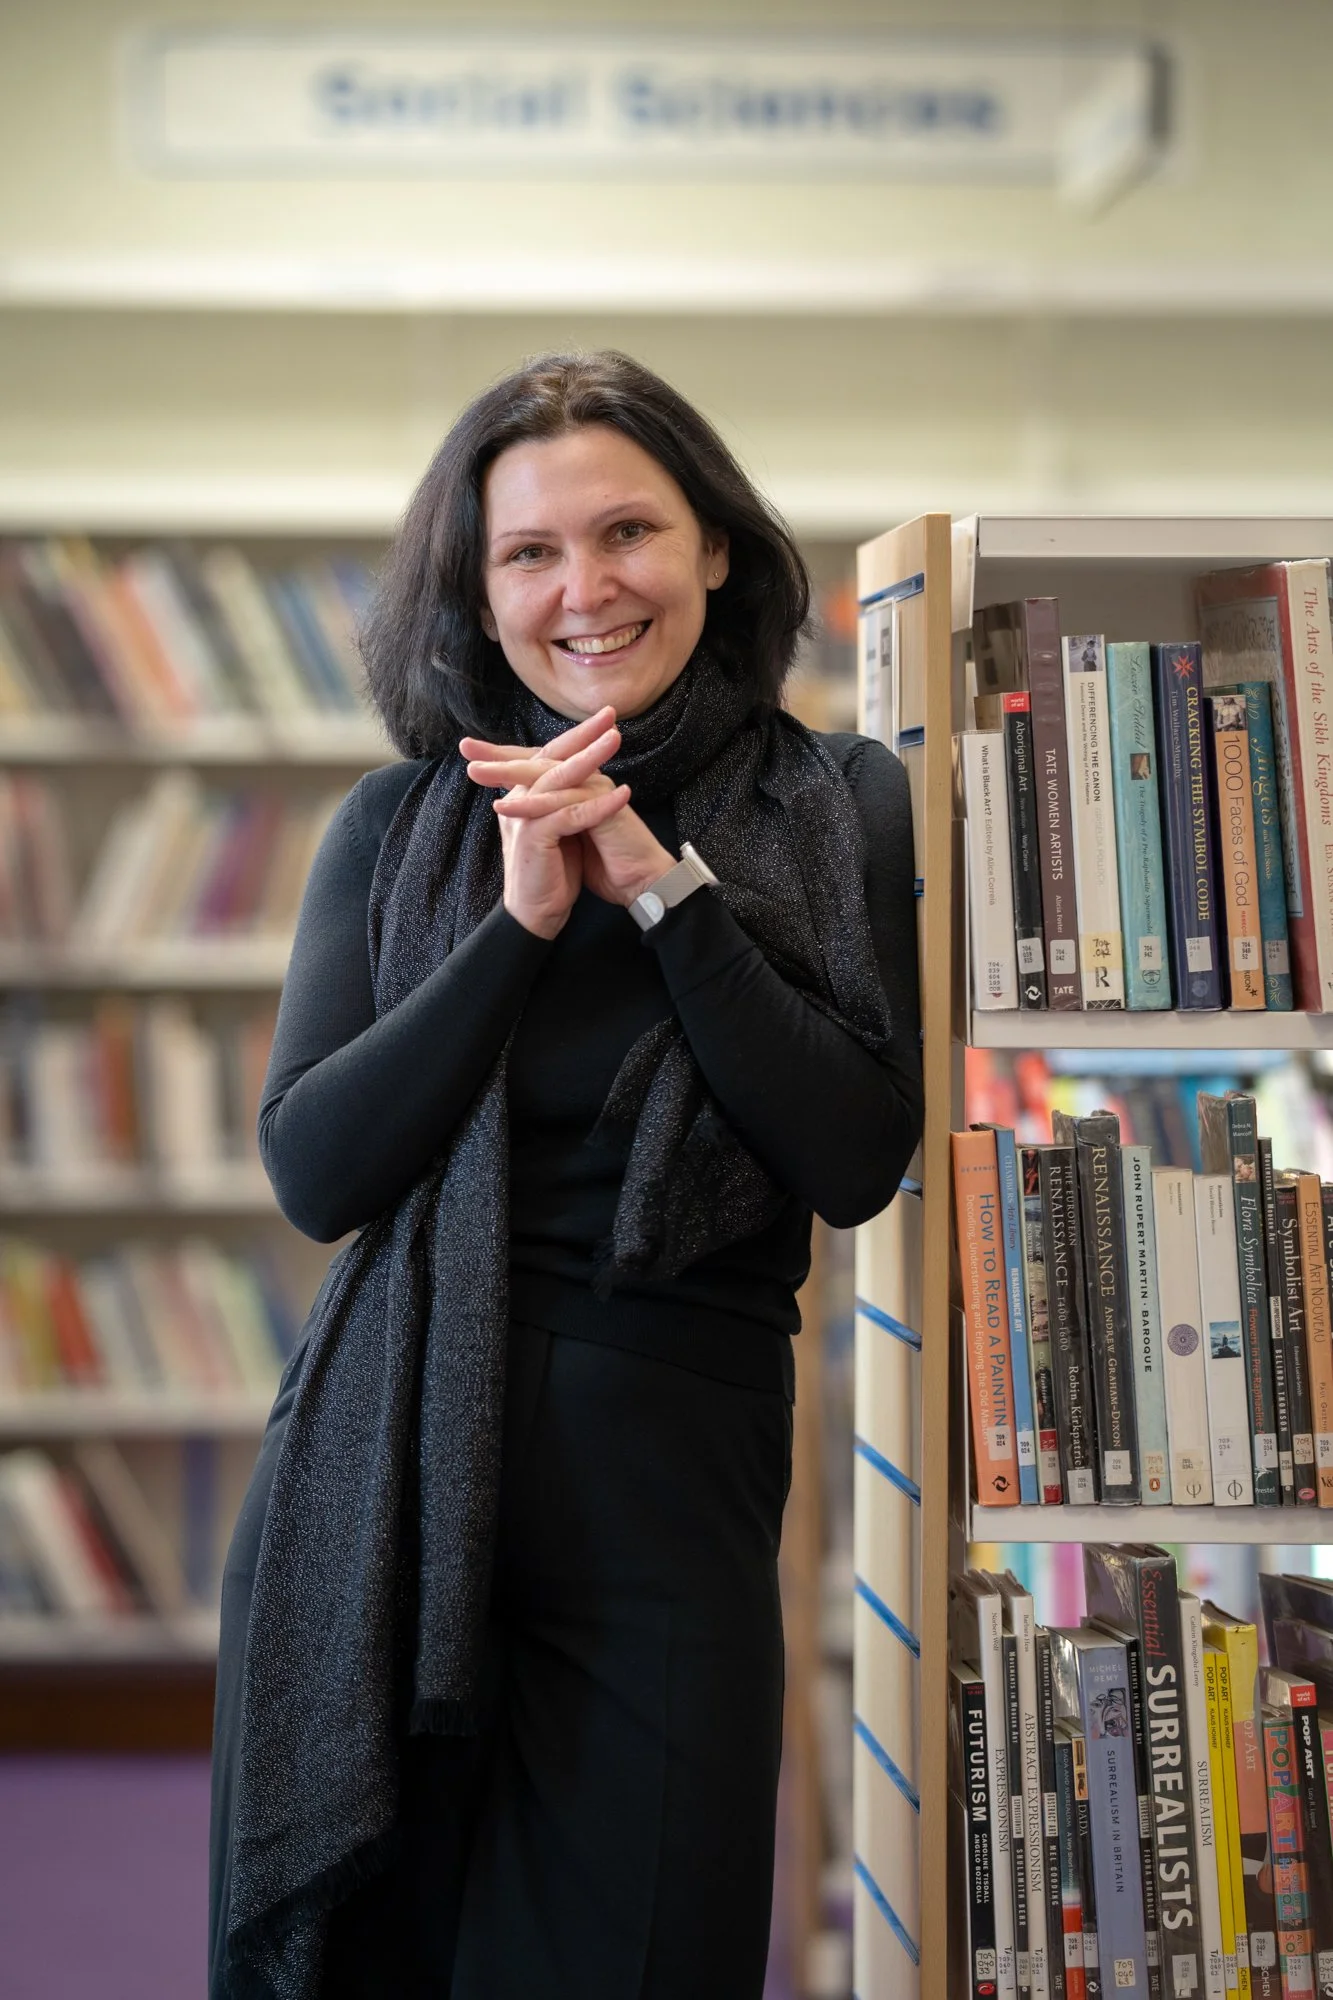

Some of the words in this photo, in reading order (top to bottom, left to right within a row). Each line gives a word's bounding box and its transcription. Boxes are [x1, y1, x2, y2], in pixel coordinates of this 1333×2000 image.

[1303, 588, 1318, 617] The
[1306, 622, 1320, 654] Arts
[1130, 656, 1141, 695] Lizzie
[1306, 663, 1324, 678] of
[1311, 682, 1324, 704] the
[1087, 682, 1098, 748] DIFFERENCING
[1186, 687, 1204, 769] CRACKING
[1313, 712, 1328, 744] Sikh
[1015, 721, 1028, 773] Aboriginal
[1045, 748, 1056, 774] TATE
[1172, 709, 1181, 779] Wallace-Murphy
[1223, 736, 1244, 791] 1000
[983, 775, 991, 798] Black
[1019, 776, 1029, 792] Art
[1047, 779, 1059, 828] WOMEN
[1092, 771, 1101, 802] CANON
[1191, 773, 1204, 804] THE
[1314, 754, 1332, 825] Kingdoms
[984, 798, 992, 815] Art?
[1229, 797, 1245, 845] Faces
[985, 819, 993, 843] Edited
[985, 845, 993, 855] by
[1192, 808, 1208, 873] SYMBOL
[987, 857, 995, 876] Alice
[1050, 833, 1062, 880] ARTISTS
[1233, 851, 1247, 865] of
[988, 878, 996, 905] Correia
[1196, 878, 1210, 921] CODE
[1234, 872, 1250, 906] God
[1056, 914, 1064, 933] Foster
[1053, 986, 1074, 995] TATE
[1064, 1165, 1073, 1187] THE
[1133, 1157, 1141, 1190] JOHN
[966, 1195, 976, 1240] Decoding,
[979, 1194, 994, 1240] HOW
[1049, 1166, 1068, 1287] RENAISSANCE
[1066, 1190, 1077, 1246] EUROPEAN
[1092, 1147, 1115, 1297] RENAISSANCE
[1135, 1195, 1144, 1245] RUPERT
[1240, 1196, 1256, 1231] Flora
[1305, 1202, 1320, 1260] ESSENTIAL
[969, 1242, 981, 1309] Understanding
[983, 1248, 996, 1272] TO
[1139, 1249, 1148, 1299] MARTIN
[1239, 1237, 1262, 1304] Symbolica
[1278, 1218, 1300, 1301] Symbolist
[1309, 1264, 1322, 1284] ART
[986, 1280, 1000, 1328] READ
[1011, 1268, 1021, 1316] RENAISSANCE
[974, 1312, 983, 1328] and
[1014, 1319, 1023, 1332] ART
[1057, 1297, 1069, 1351] 1400-1600
[1104, 1306, 1114, 1353] ANDREW
[1248, 1308, 1258, 1345] Flowers
[1288, 1306, 1303, 1333] Art
[1310, 1287, 1326, 1343] NOUVEAU
[974, 1331, 985, 1370] Enjoying
[989, 1336, 1001, 1347] A
[1142, 1310, 1152, 1373] BAROQUE
[979, 1373, 987, 1387] the
[1068, 1366, 1078, 1400] Robin
[1275, 1349, 1284, 1386] BELINDA
[980, 1390, 989, 1406] Old
[991, 1354, 1007, 1427] PAINTIN
[1107, 1358, 1121, 1447] GRAHAM-DIXON
[1251, 1359, 1264, 1427] Pre-Raphaelite
[1278, 1392, 1287, 1432] THOMSON
[1140, 1568, 1166, 1657] Essential
[1042, 1649, 1050, 1687] MOVEMENTS
[1206, 1667, 1214, 1684] POP
[1207, 1686, 1216, 1702] ART
[1190, 1616, 1198, 1639] Cathrin
[1197, 1761, 1212, 1847] SURREALISM
[1243, 1711, 1254, 1739] POP
[1301, 1715, 1311, 1745] POP
[968, 1709, 986, 1822] FUTURISM
[1024, 1712, 1037, 1783] ABSTRACT
[1244, 1743, 1258, 1772] ART
[1270, 1729, 1291, 1786] POP
[1304, 1748, 1314, 1778] ART
[995, 1749, 1009, 1853] EXPRESSIONISM
[1107, 1750, 1119, 1824] SURREALISM
[1146, 1664, 1192, 1930] SURREALISTS
[1027, 1787, 1041, 1892] EXPRESSIONISM
[1048, 1825, 1056, 1835] ART
[1078, 1804, 1087, 1836] DADA
[1113, 1830, 1121, 1841] IN
[1274, 1791, 1297, 1849] ART
[1049, 1845, 1057, 1861] MEL
[1114, 1847, 1124, 1893] BRITAIN
[1144, 1849, 1152, 1875] FIONA
[975, 1866, 983, 1904] BOZZOLLA
[982, 1873, 990, 1904] TISDALL
[1016, 1848, 1025, 1899] SHULAMITH
[1050, 1866, 1059, 1906] GOODING
[1279, 1858, 1293, 1925] HISTORY
[1018, 1904, 1026, 1926] BEHR
[1145, 1881, 1154, 1920] BRADLEY
